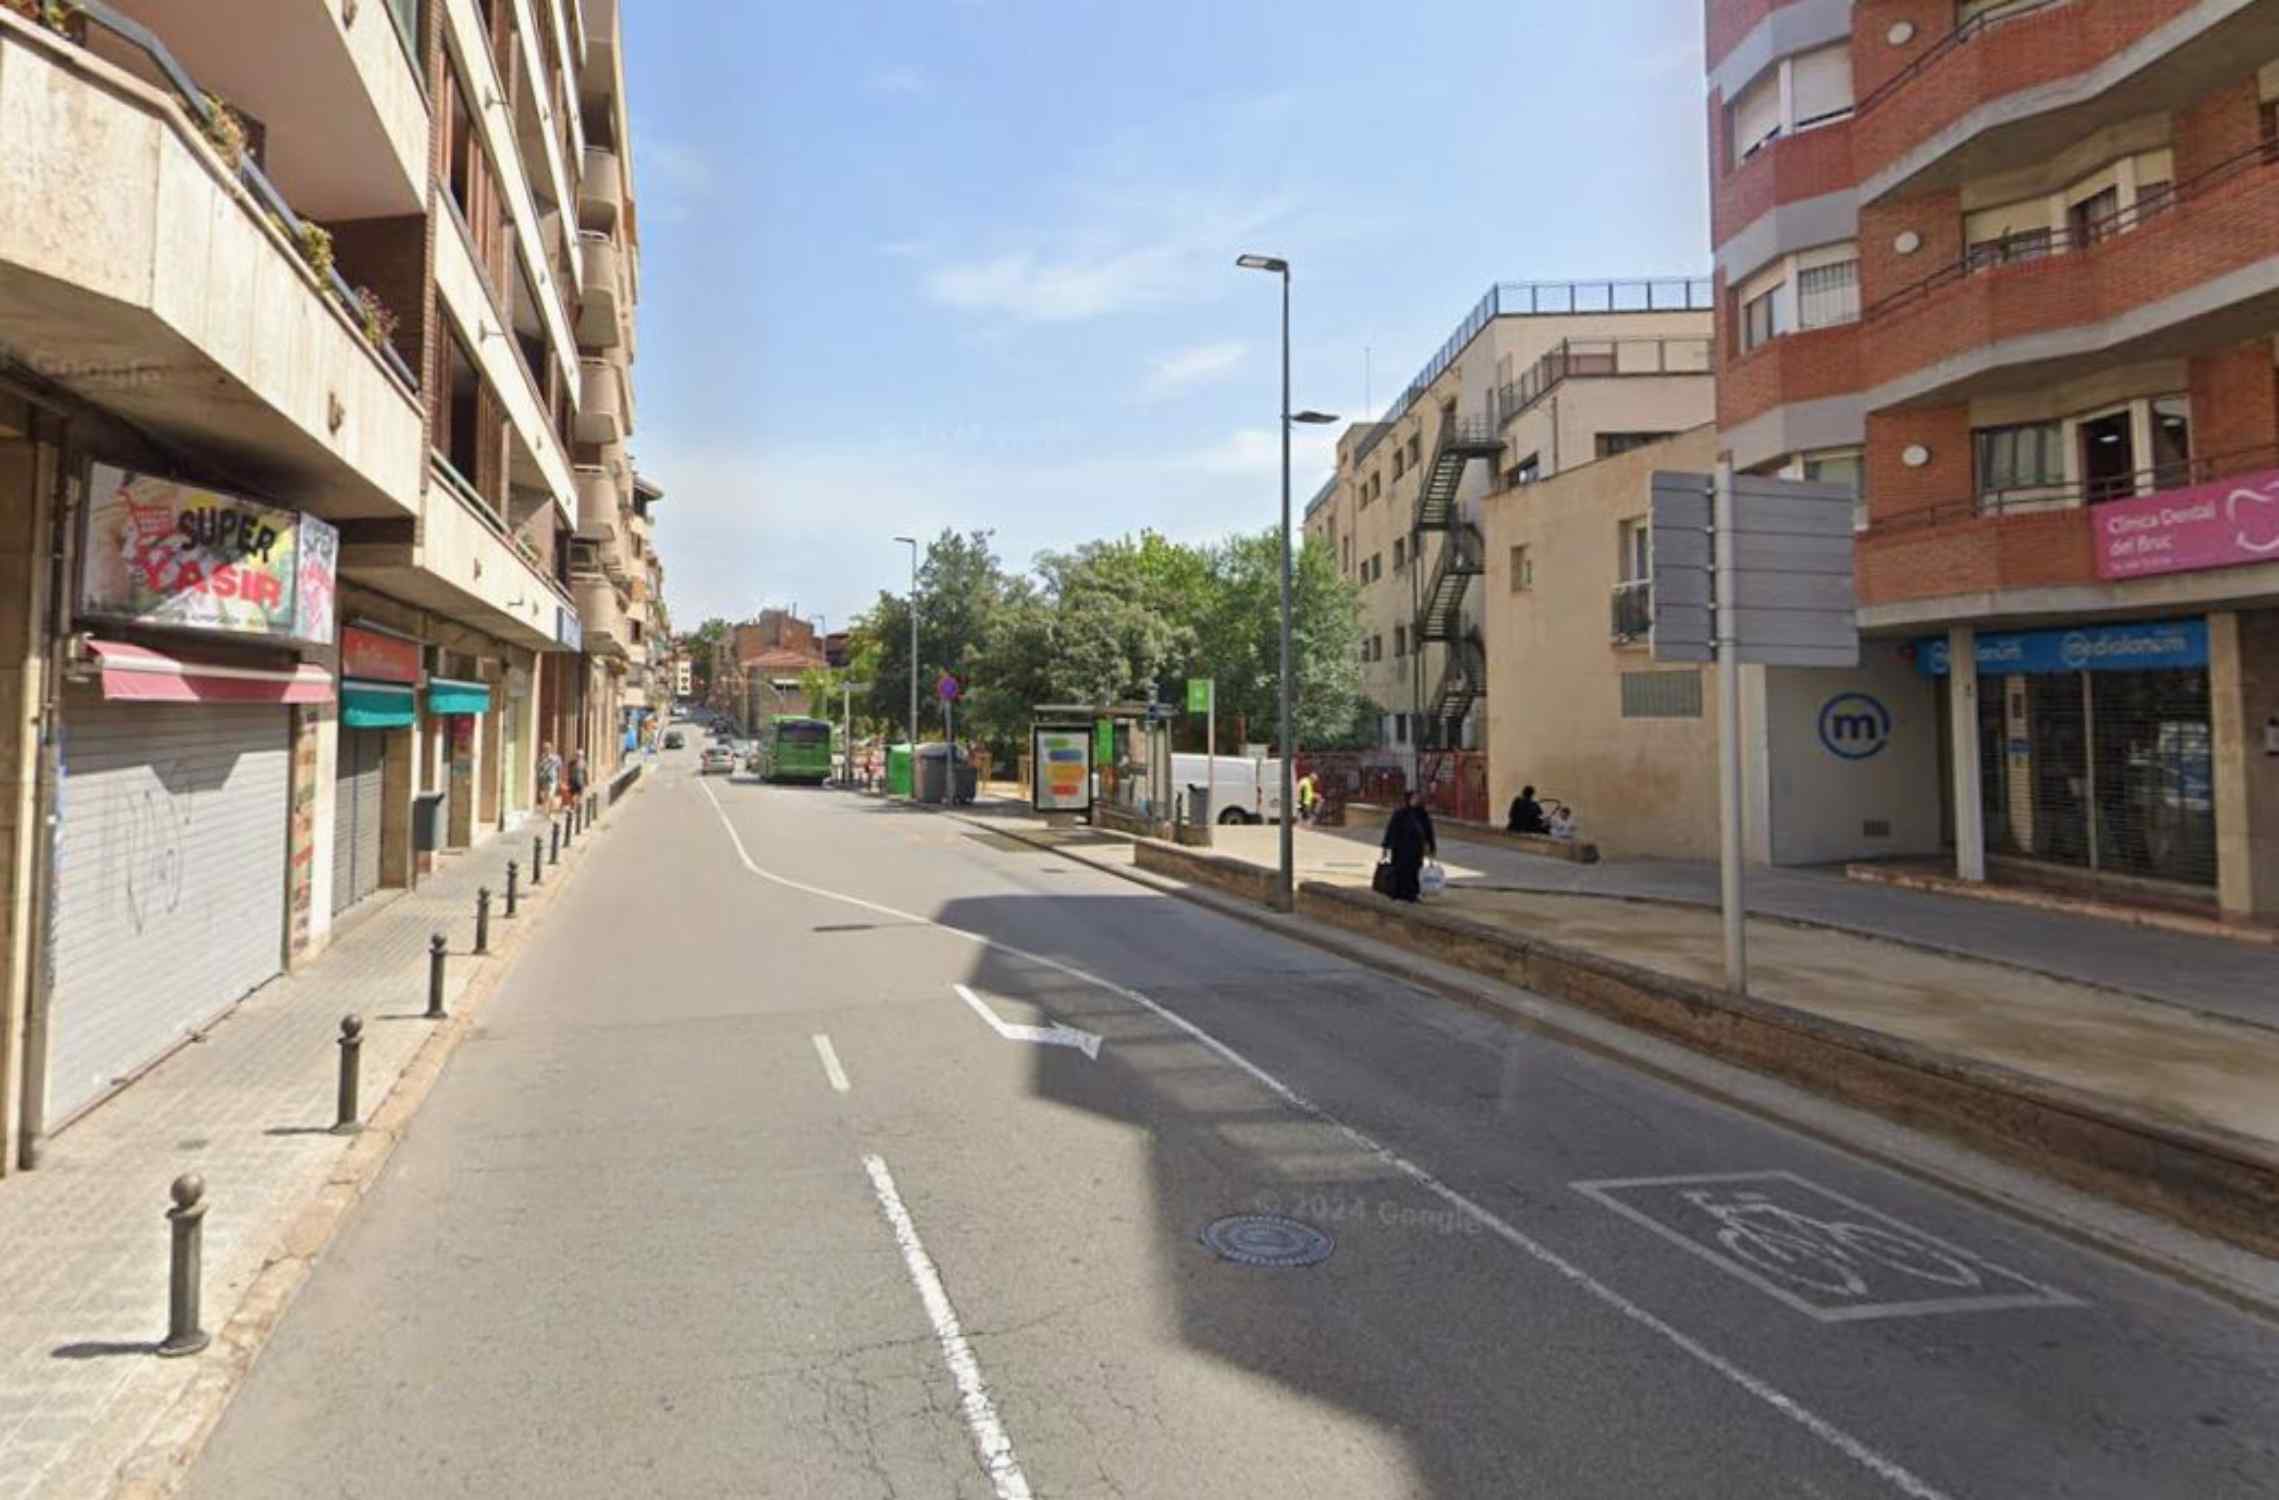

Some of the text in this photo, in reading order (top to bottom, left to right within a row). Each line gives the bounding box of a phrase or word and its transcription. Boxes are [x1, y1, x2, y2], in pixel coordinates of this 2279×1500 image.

[2160, 501, 2216, 525] Dental
[177, 505, 276, 563] SUPER
[2109, 535, 2135, 557] del
